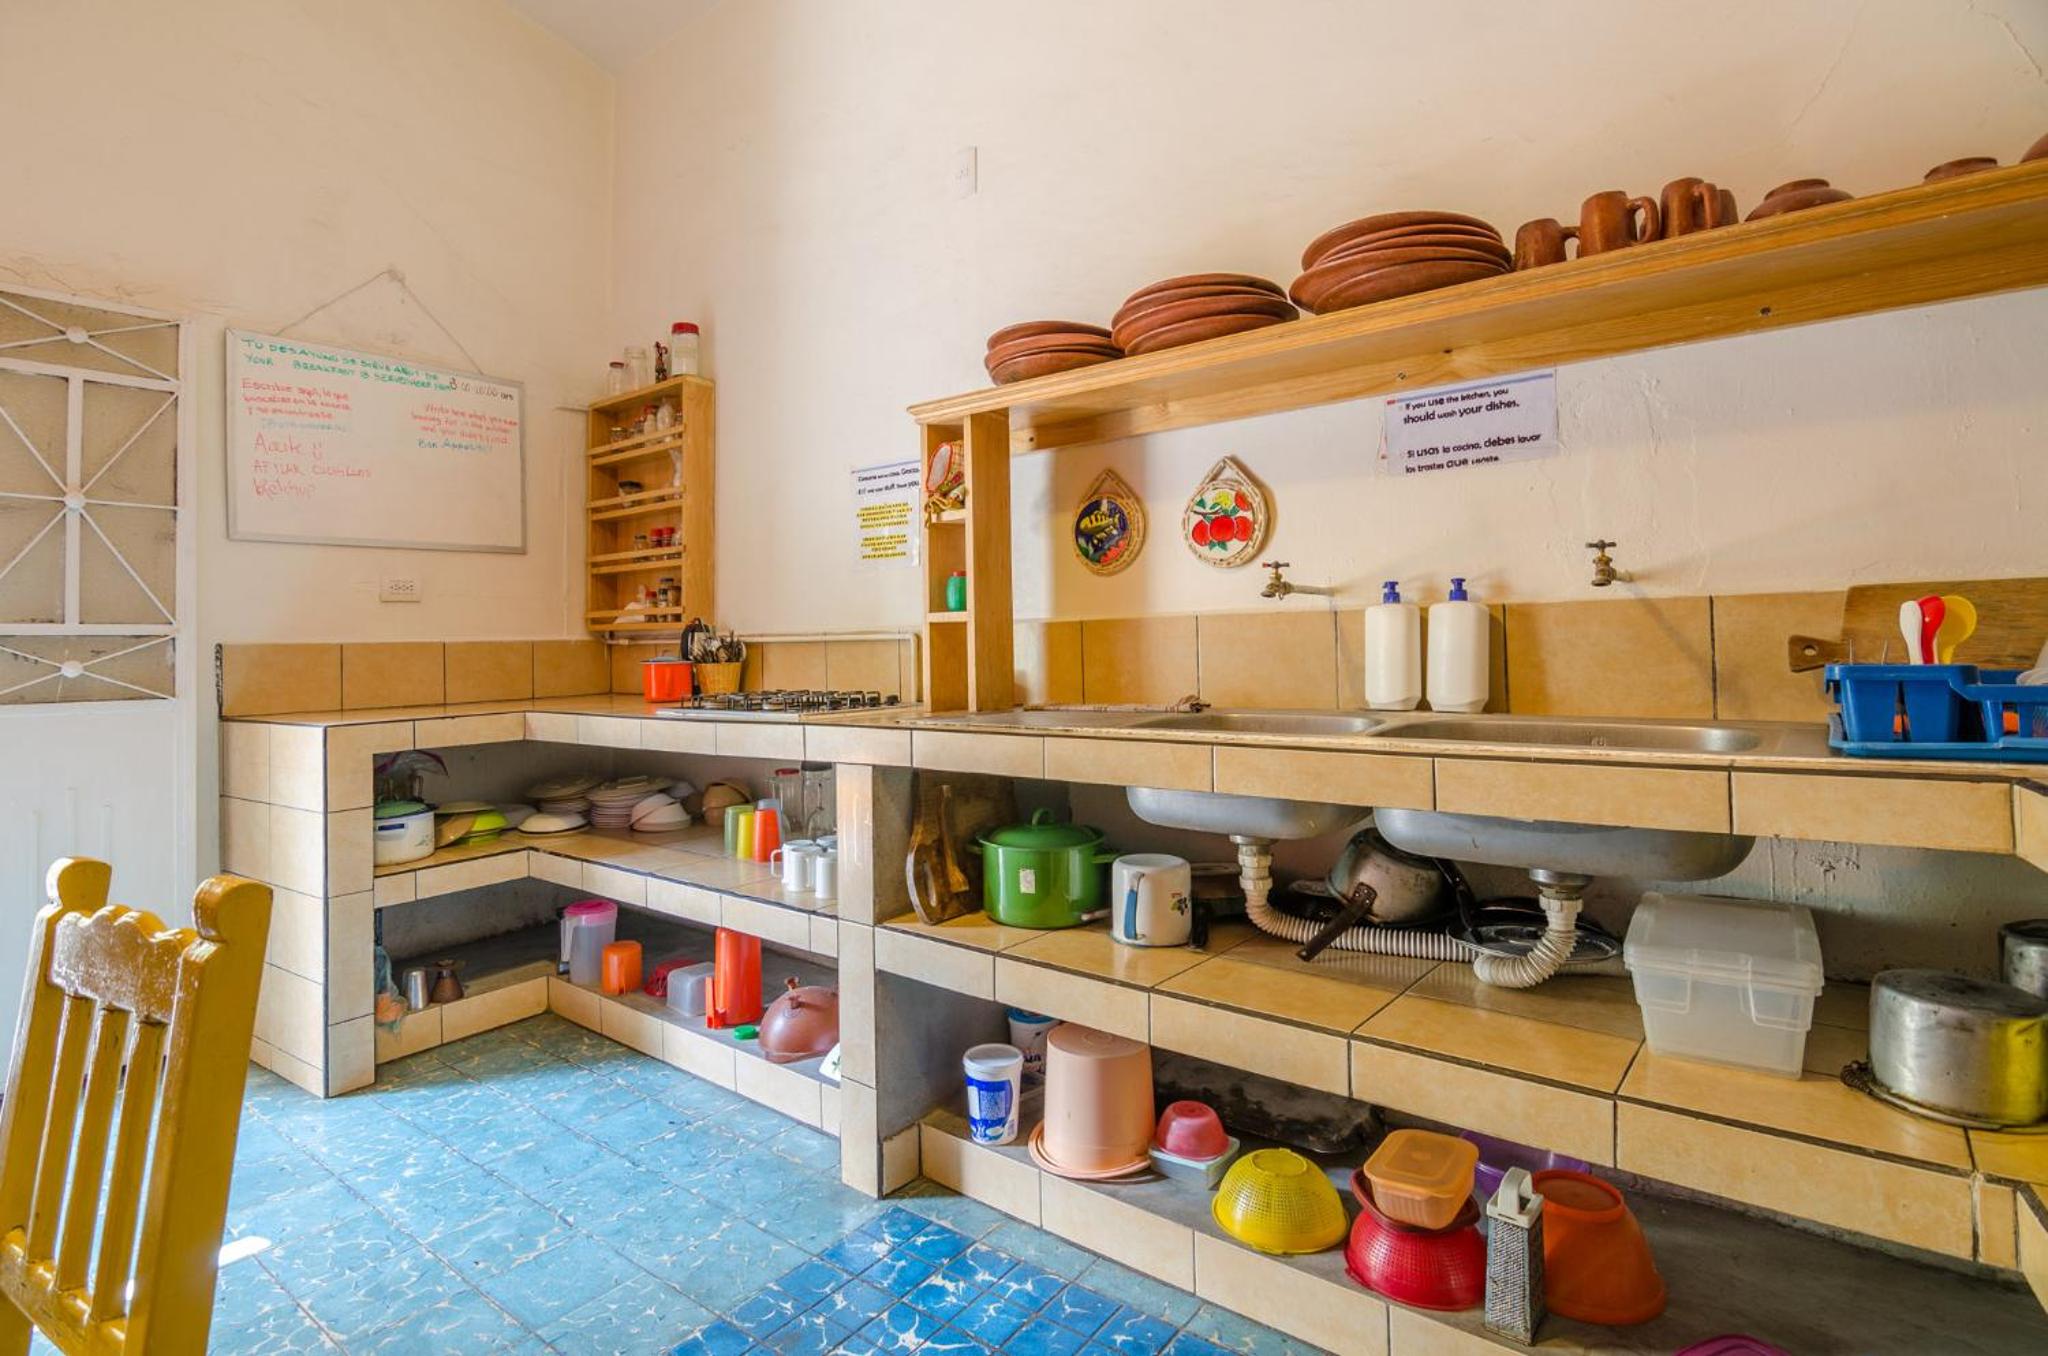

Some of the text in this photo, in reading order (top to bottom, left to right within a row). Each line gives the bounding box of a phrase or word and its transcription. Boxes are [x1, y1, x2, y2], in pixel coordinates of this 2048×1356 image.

[1412, 401, 1426, 411] you
[1446, 395, 1459, 405] the
[1493, 386, 1509, 398] you
[1403, 398, 1520, 425] should wash your dishes.
[1442, 444, 1451, 454] la
[1484, 436, 1516, 449] debes
[1517, 432, 1541, 444] lavar
[1405, 463, 1417, 475] los
[1417, 461, 1445, 473] trastes
